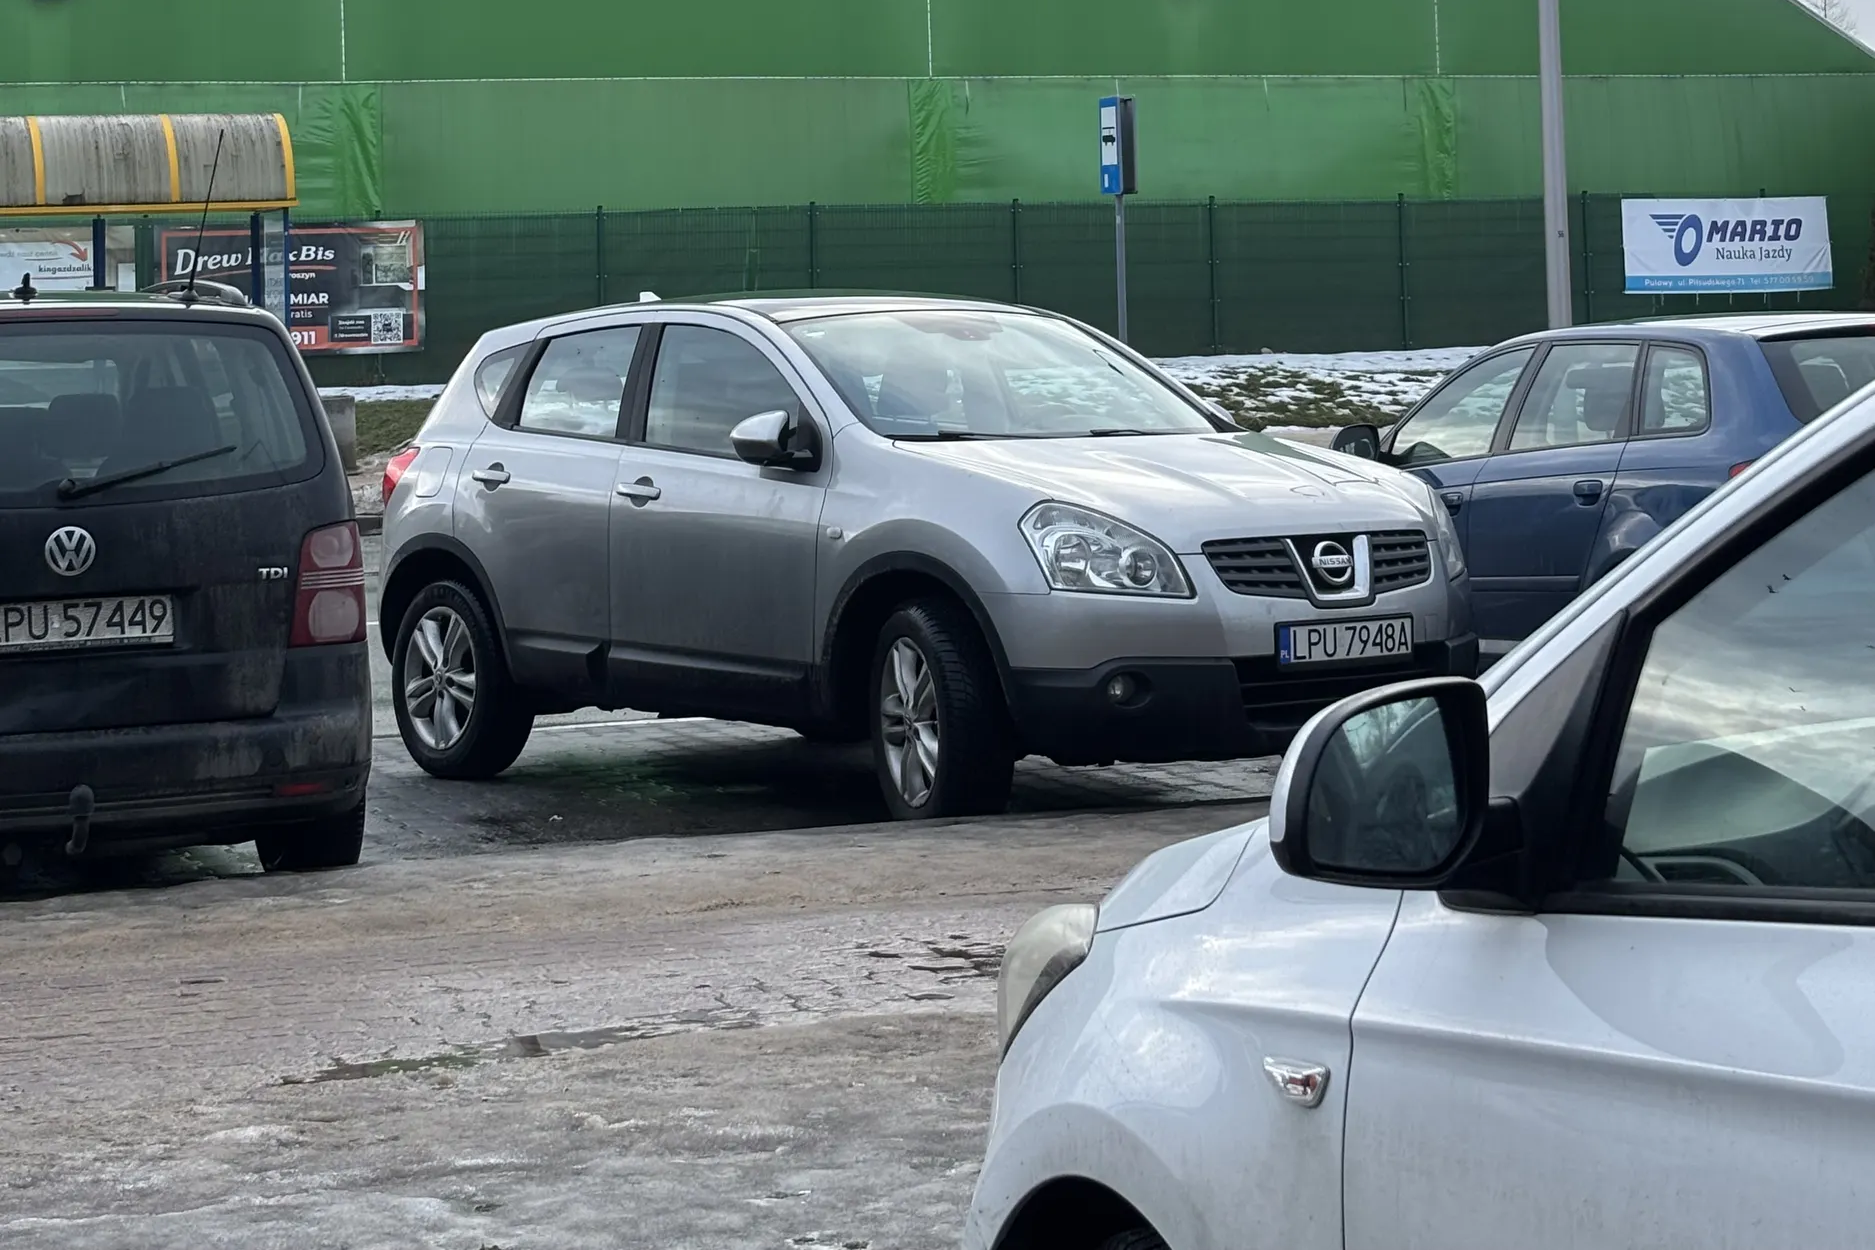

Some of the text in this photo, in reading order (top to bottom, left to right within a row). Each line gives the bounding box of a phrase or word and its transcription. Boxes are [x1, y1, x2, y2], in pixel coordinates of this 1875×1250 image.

[1706, 218, 1803, 243] MARIO
[174, 248, 242, 275] Drew
[1715, 245, 1793, 262] Nauka Jazdy
[1318, 556, 1352, 566] NISSAN
[258, 566, 289, 580] TDI
[62, 598, 168, 637] 57449
[1292, 621, 1409, 660] LPU 7948A
[1280, 649, 1290, 659] PL
